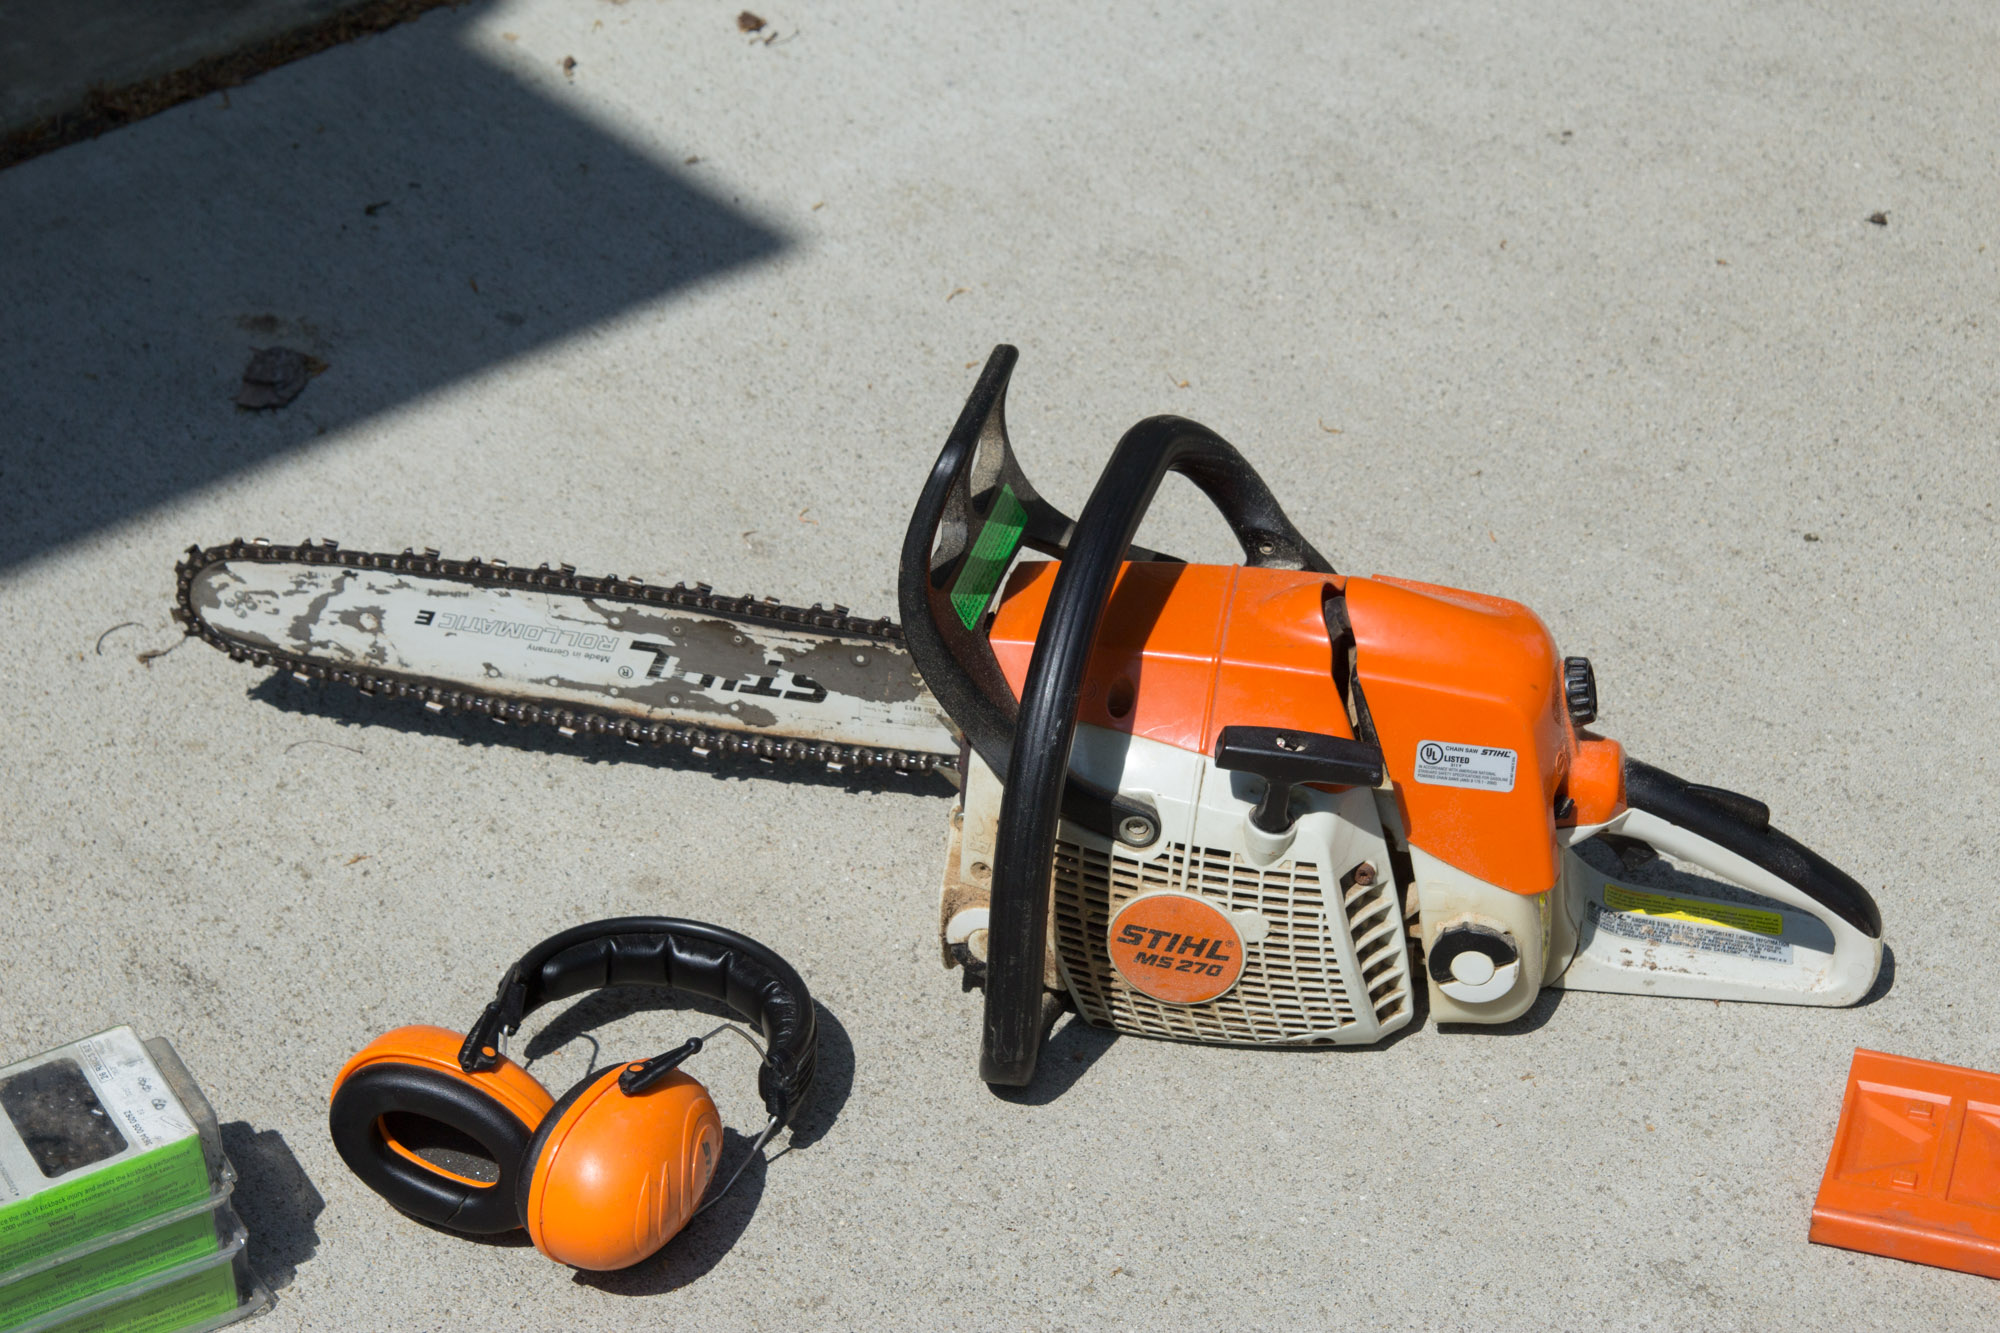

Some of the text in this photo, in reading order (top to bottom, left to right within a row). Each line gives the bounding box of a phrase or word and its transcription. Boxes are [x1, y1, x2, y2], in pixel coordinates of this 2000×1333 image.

[415, 609, 619, 653] ROLLOMATIC E
[526, 642, 611, 663] Made in Germany
[625, 640, 831, 704] STL
[1426, 748, 1438, 761] UL
[1444, 755, 1470, 765] LISTED
[1481, 749, 1511, 758] STIHL
[1117, 924, 1230, 961] STIHL
[1134, 952, 1223, 977] MS 270
[20, 1210, 31, 1218] risk
[40, 1197, 66, 1211] kickback
[67, 1191, 84, 1201] injury
[85, 1185, 97, 1194] and
[97, 1179, 116, 1189] meets
[116, 1174, 126, 1182] the
[127, 1164, 153, 1178] kickback
[153, 1150, 191, 1168] performance
[18, 1218, 35, 1227] when
[36, 1211, 54, 1220] tested
[69, 1189, 113, 1208] representative
